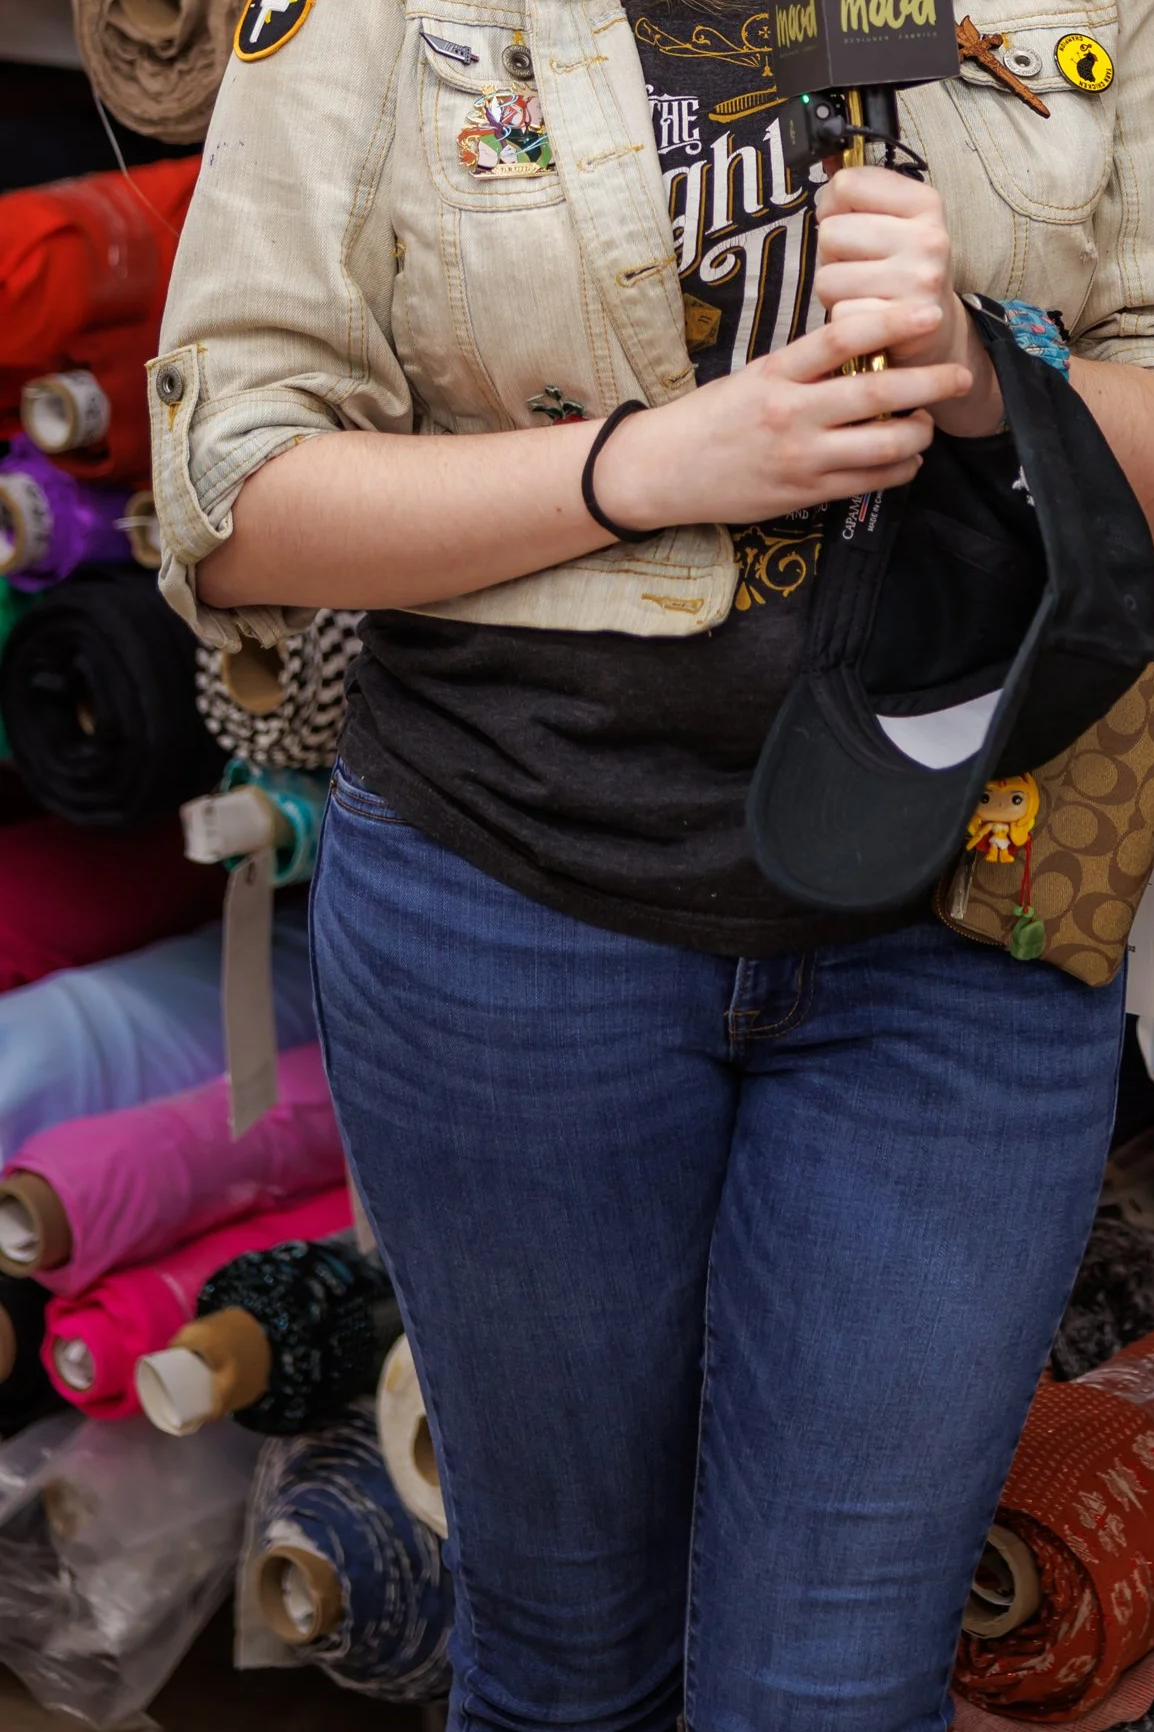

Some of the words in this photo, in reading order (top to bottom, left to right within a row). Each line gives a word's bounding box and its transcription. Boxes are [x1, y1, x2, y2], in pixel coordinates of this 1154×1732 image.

[843, 35, 889, 44] DESIGNER
[898, 31, 938, 40] FABRICS
[1104, 67, 1112, 83] YARN
[1079, 80, 1106, 90] CHICKEN
[648, 84, 702, 155] THE
[661, 117, 806, 273] ght
